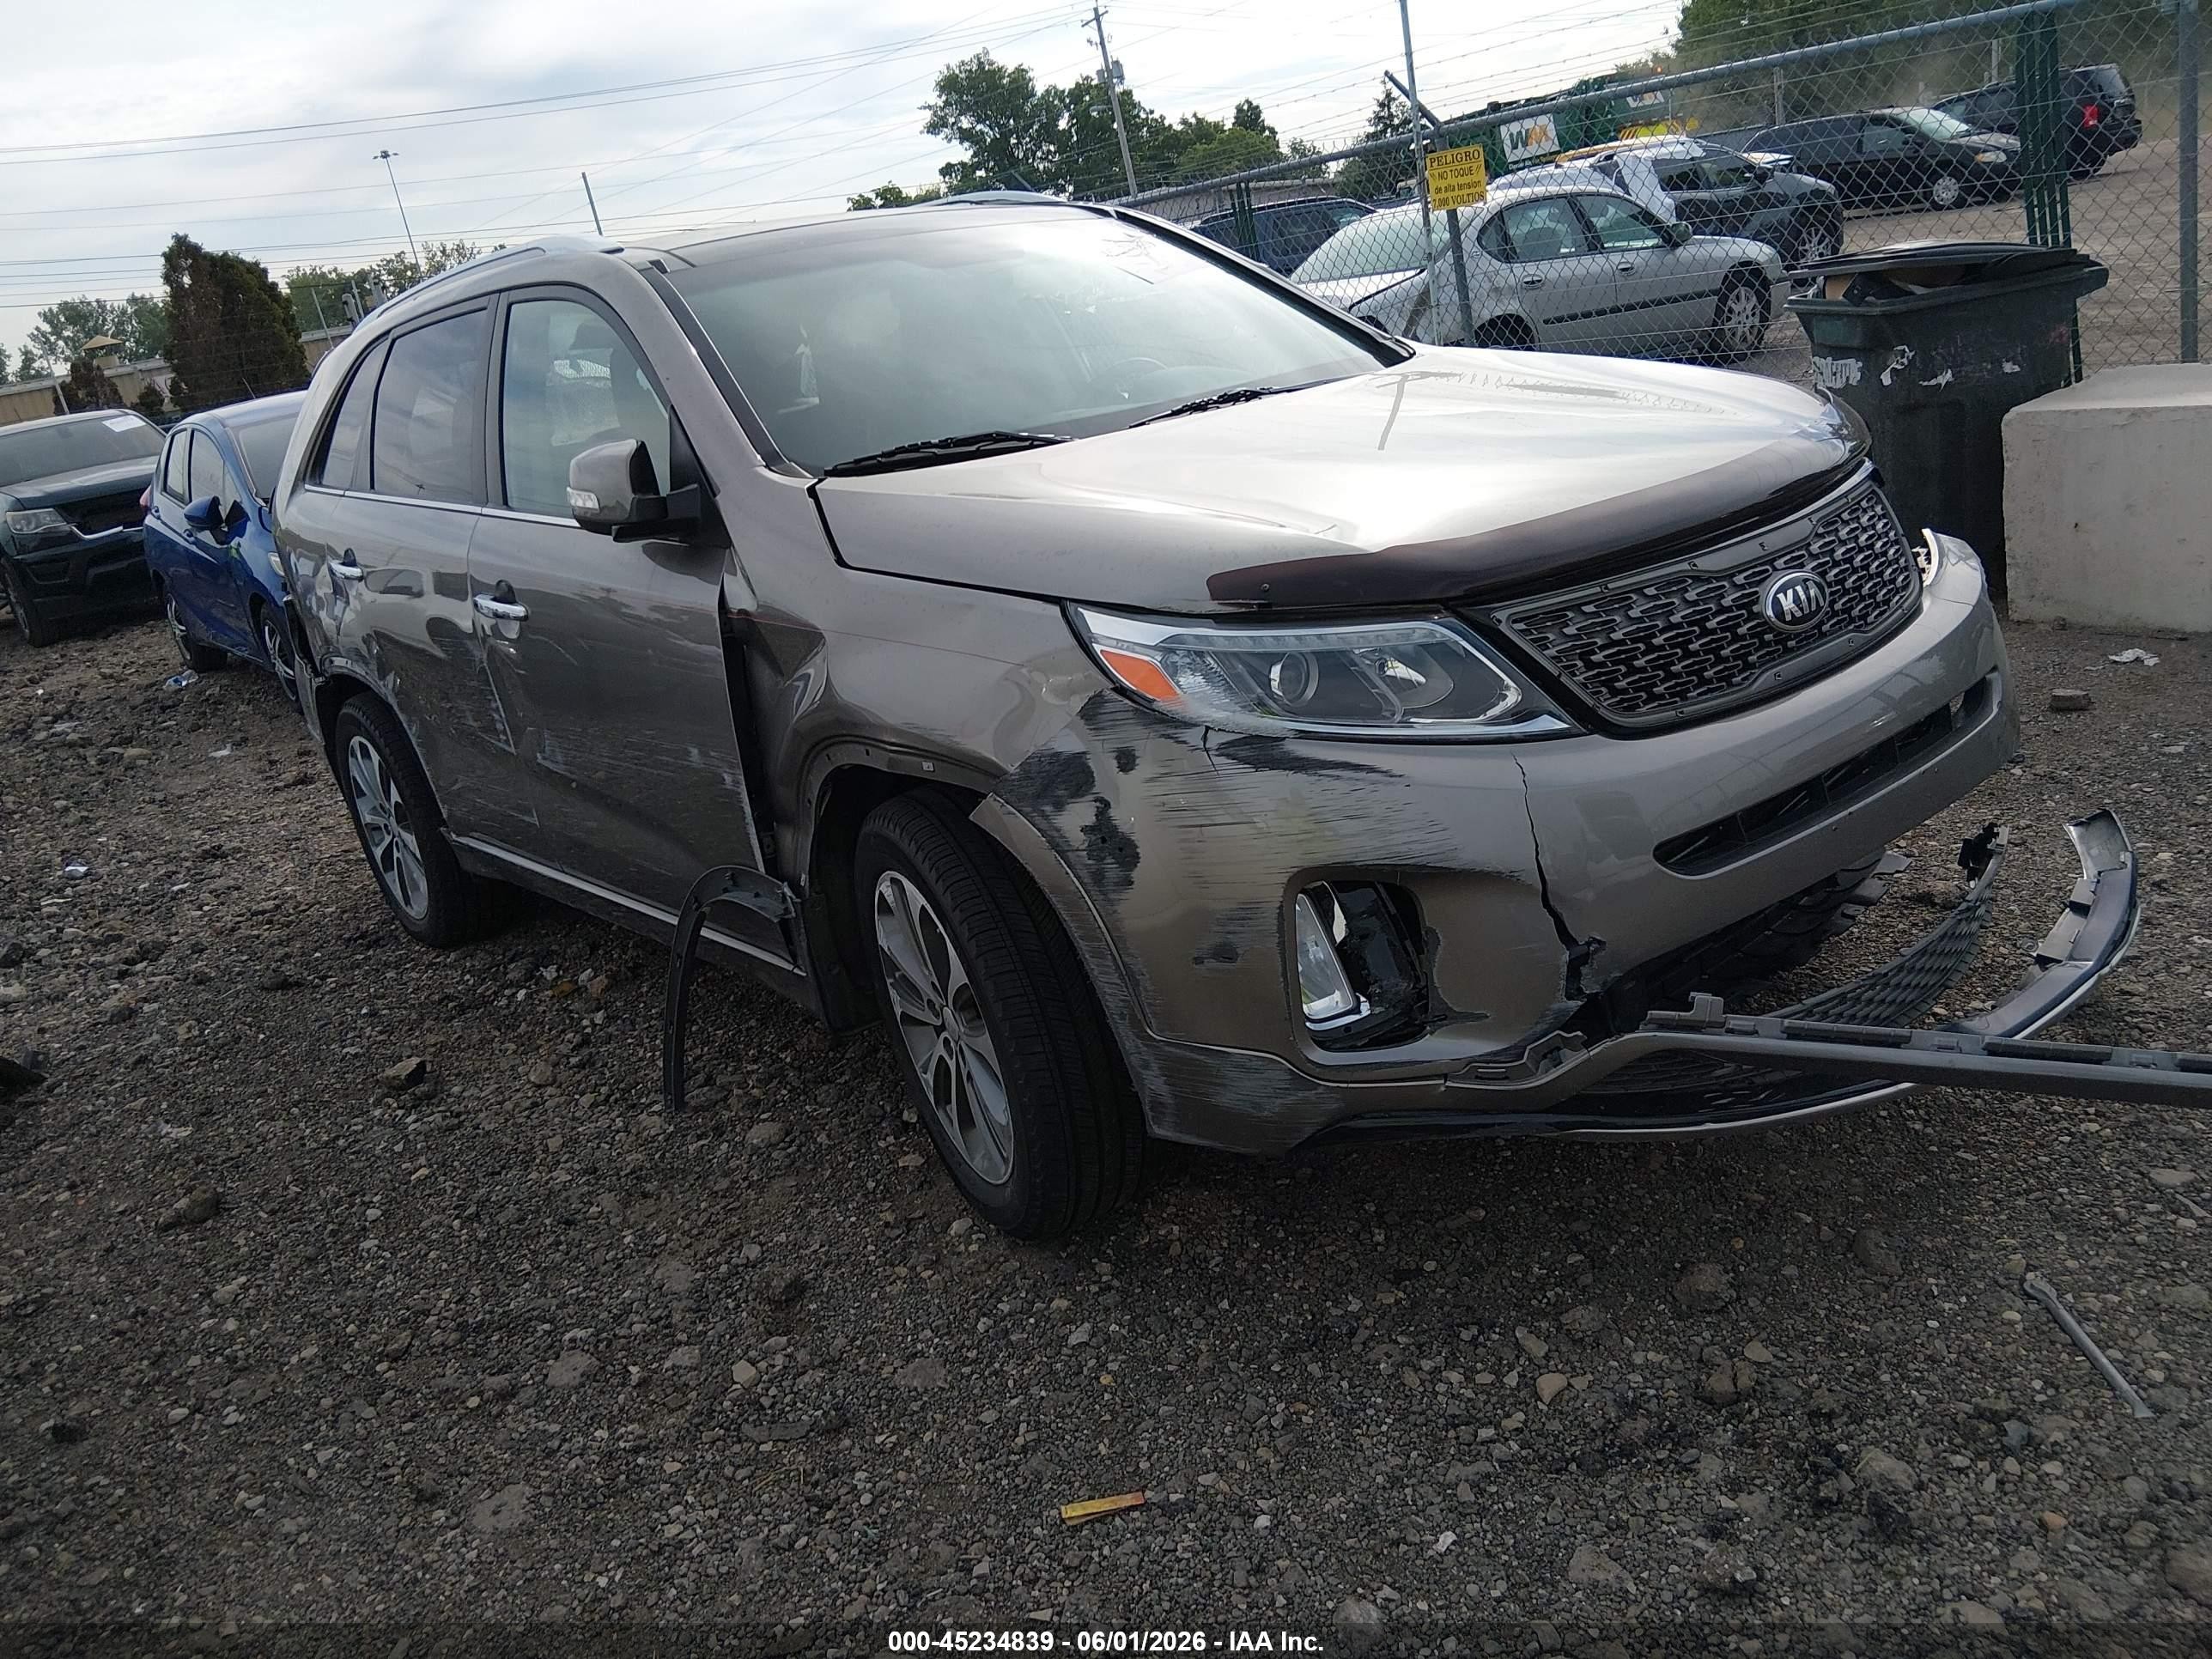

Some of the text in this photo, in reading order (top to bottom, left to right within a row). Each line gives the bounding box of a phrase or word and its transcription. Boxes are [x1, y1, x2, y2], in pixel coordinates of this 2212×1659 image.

[1429, 149, 1480, 168] PELIGRO
[1438, 166, 1474, 181] NO TOQUE
[1435, 179, 1482, 195] de alta tension
[1451, 191, 1485, 206] VOLTIOS
[1777, 580, 1825, 621] KIA
